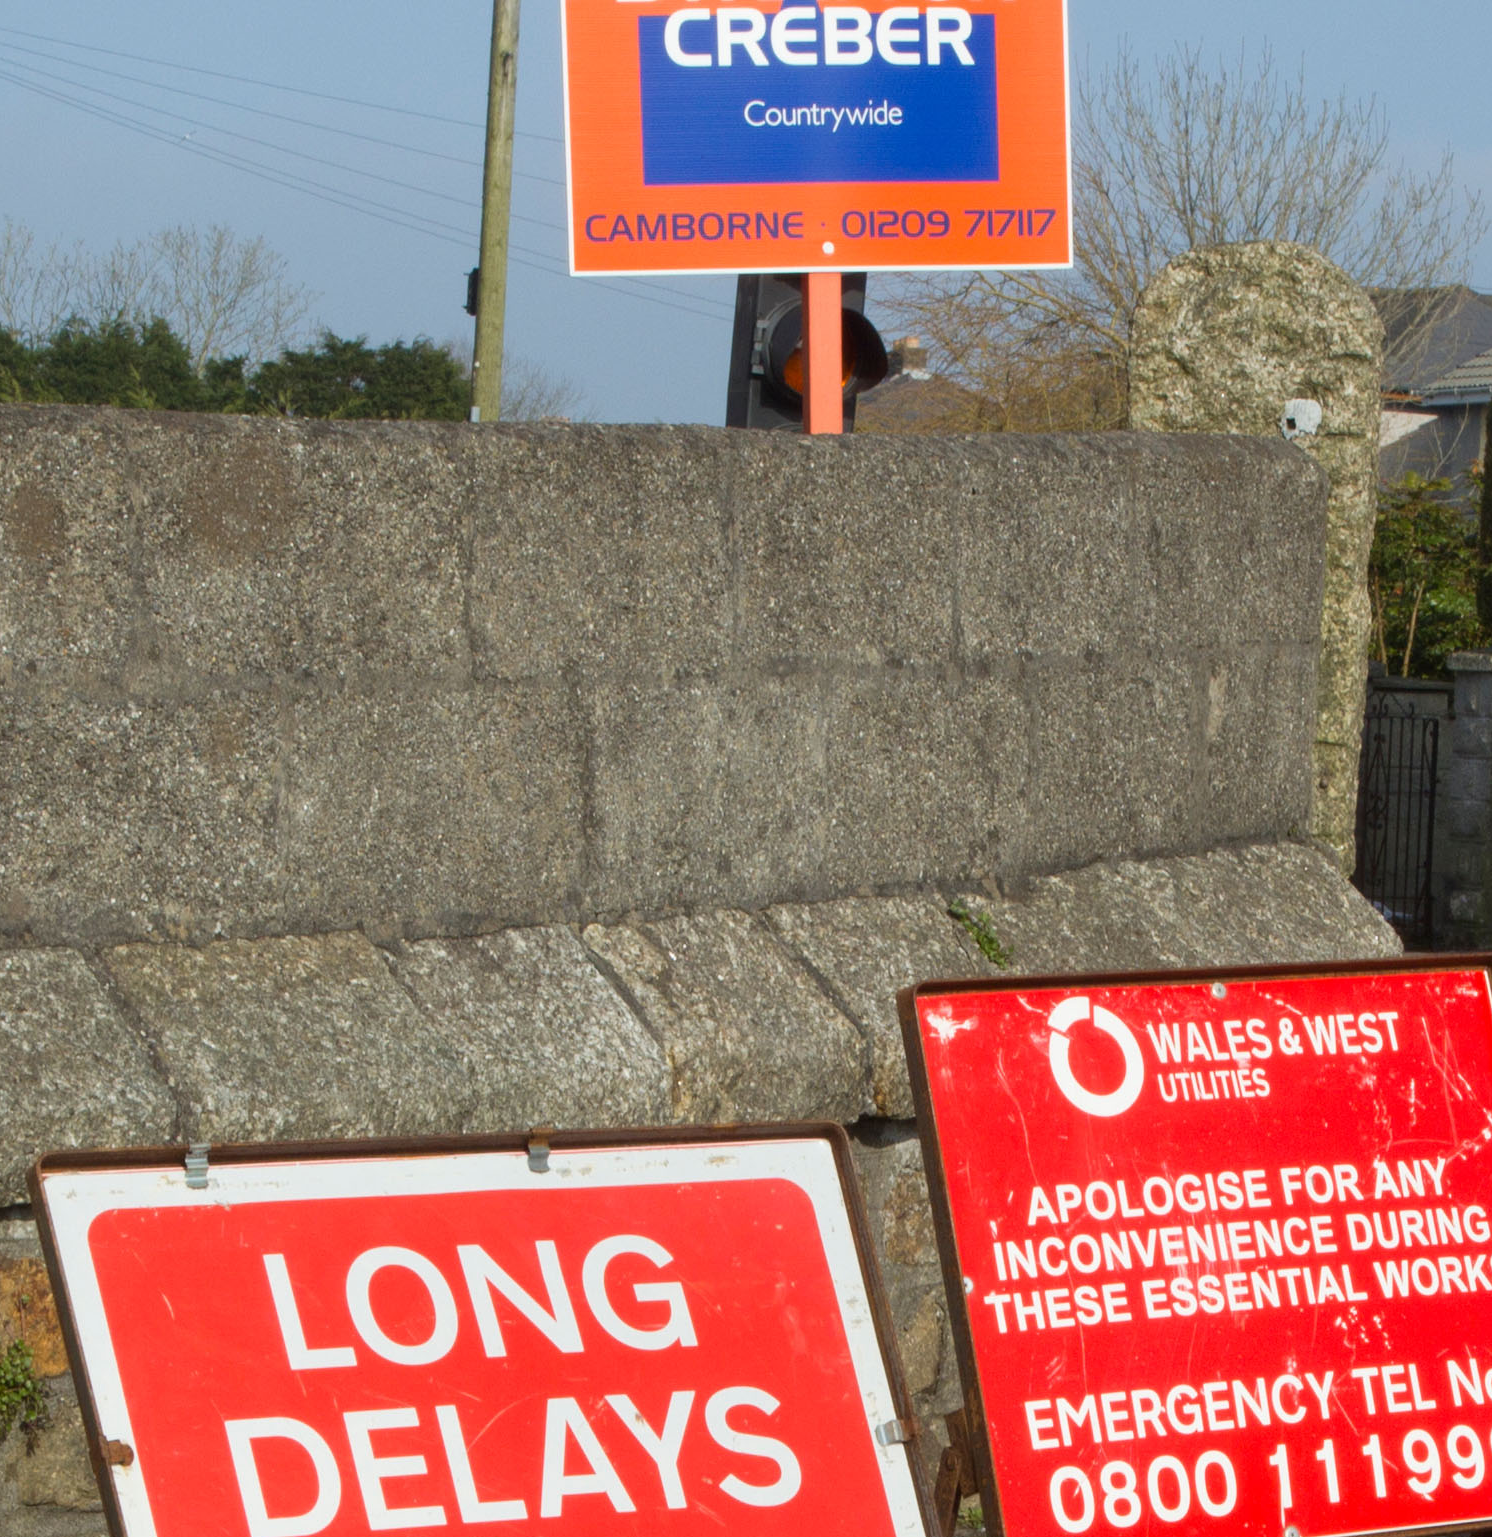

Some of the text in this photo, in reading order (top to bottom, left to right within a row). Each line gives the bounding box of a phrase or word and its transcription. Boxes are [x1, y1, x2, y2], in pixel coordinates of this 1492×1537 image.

[663, 6, 976, 68] CREBER
[743, 100, 904, 133] Countrywide
[584, 207, 1058, 242] CAMBORNE 01209 717117
[1146, 1011, 1401, 1064] WALES & WEST
[1158, 1067, 1271, 1103] UTILITIES
[1027, 1158, 1447, 1226] APOLOGISE FOR ANY
[993, 1205, 1492, 1283] INCONVENIENCE DURING
[264, 1233, 699, 1372] LONG
[984, 1289, 1133, 1336] THESE
[1141, 1264, 1367, 1318] ESSENTIAL
[1024, 1370, 1335, 1450] EMERGENCY
[1352, 1364, 1437, 1416] TEL
[1049, 1449, 1238, 1535] 0800
